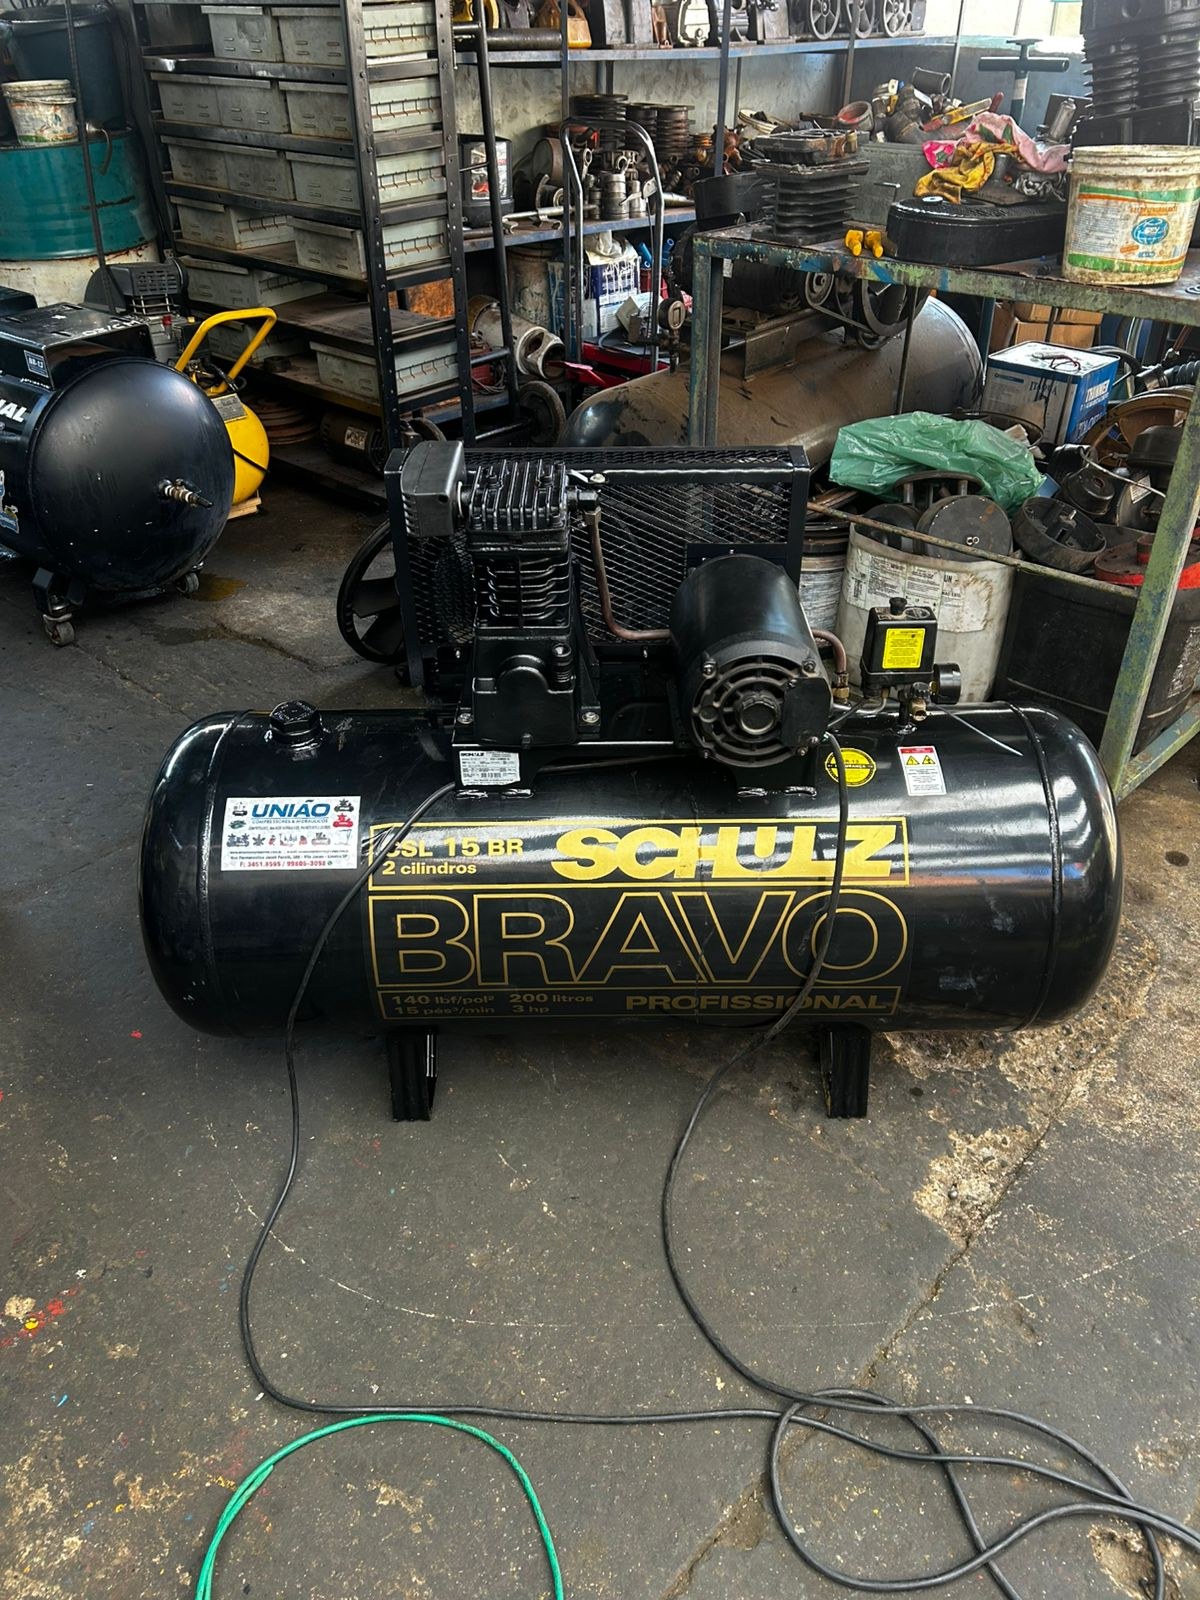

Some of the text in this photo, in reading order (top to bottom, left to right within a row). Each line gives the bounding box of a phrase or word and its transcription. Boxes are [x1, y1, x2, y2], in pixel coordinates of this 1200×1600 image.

[251, 799, 331, 818] UNIÃO
[443, 836, 480, 857] 15
[487, 838, 524, 857] BR
[551, 825, 897, 881] SCHULZ
[382, 861, 477, 875] 2 cilindros
[368, 890, 908, 987] BRAVO
[392, 995, 431, 1005] 140
[509, 993, 594, 1003] 200 litros
[625, 994, 887, 1010] PROFISSIONAL
[395, 1006, 419, 1015] 15
[512, 1005, 550, 1014] 3 hp
